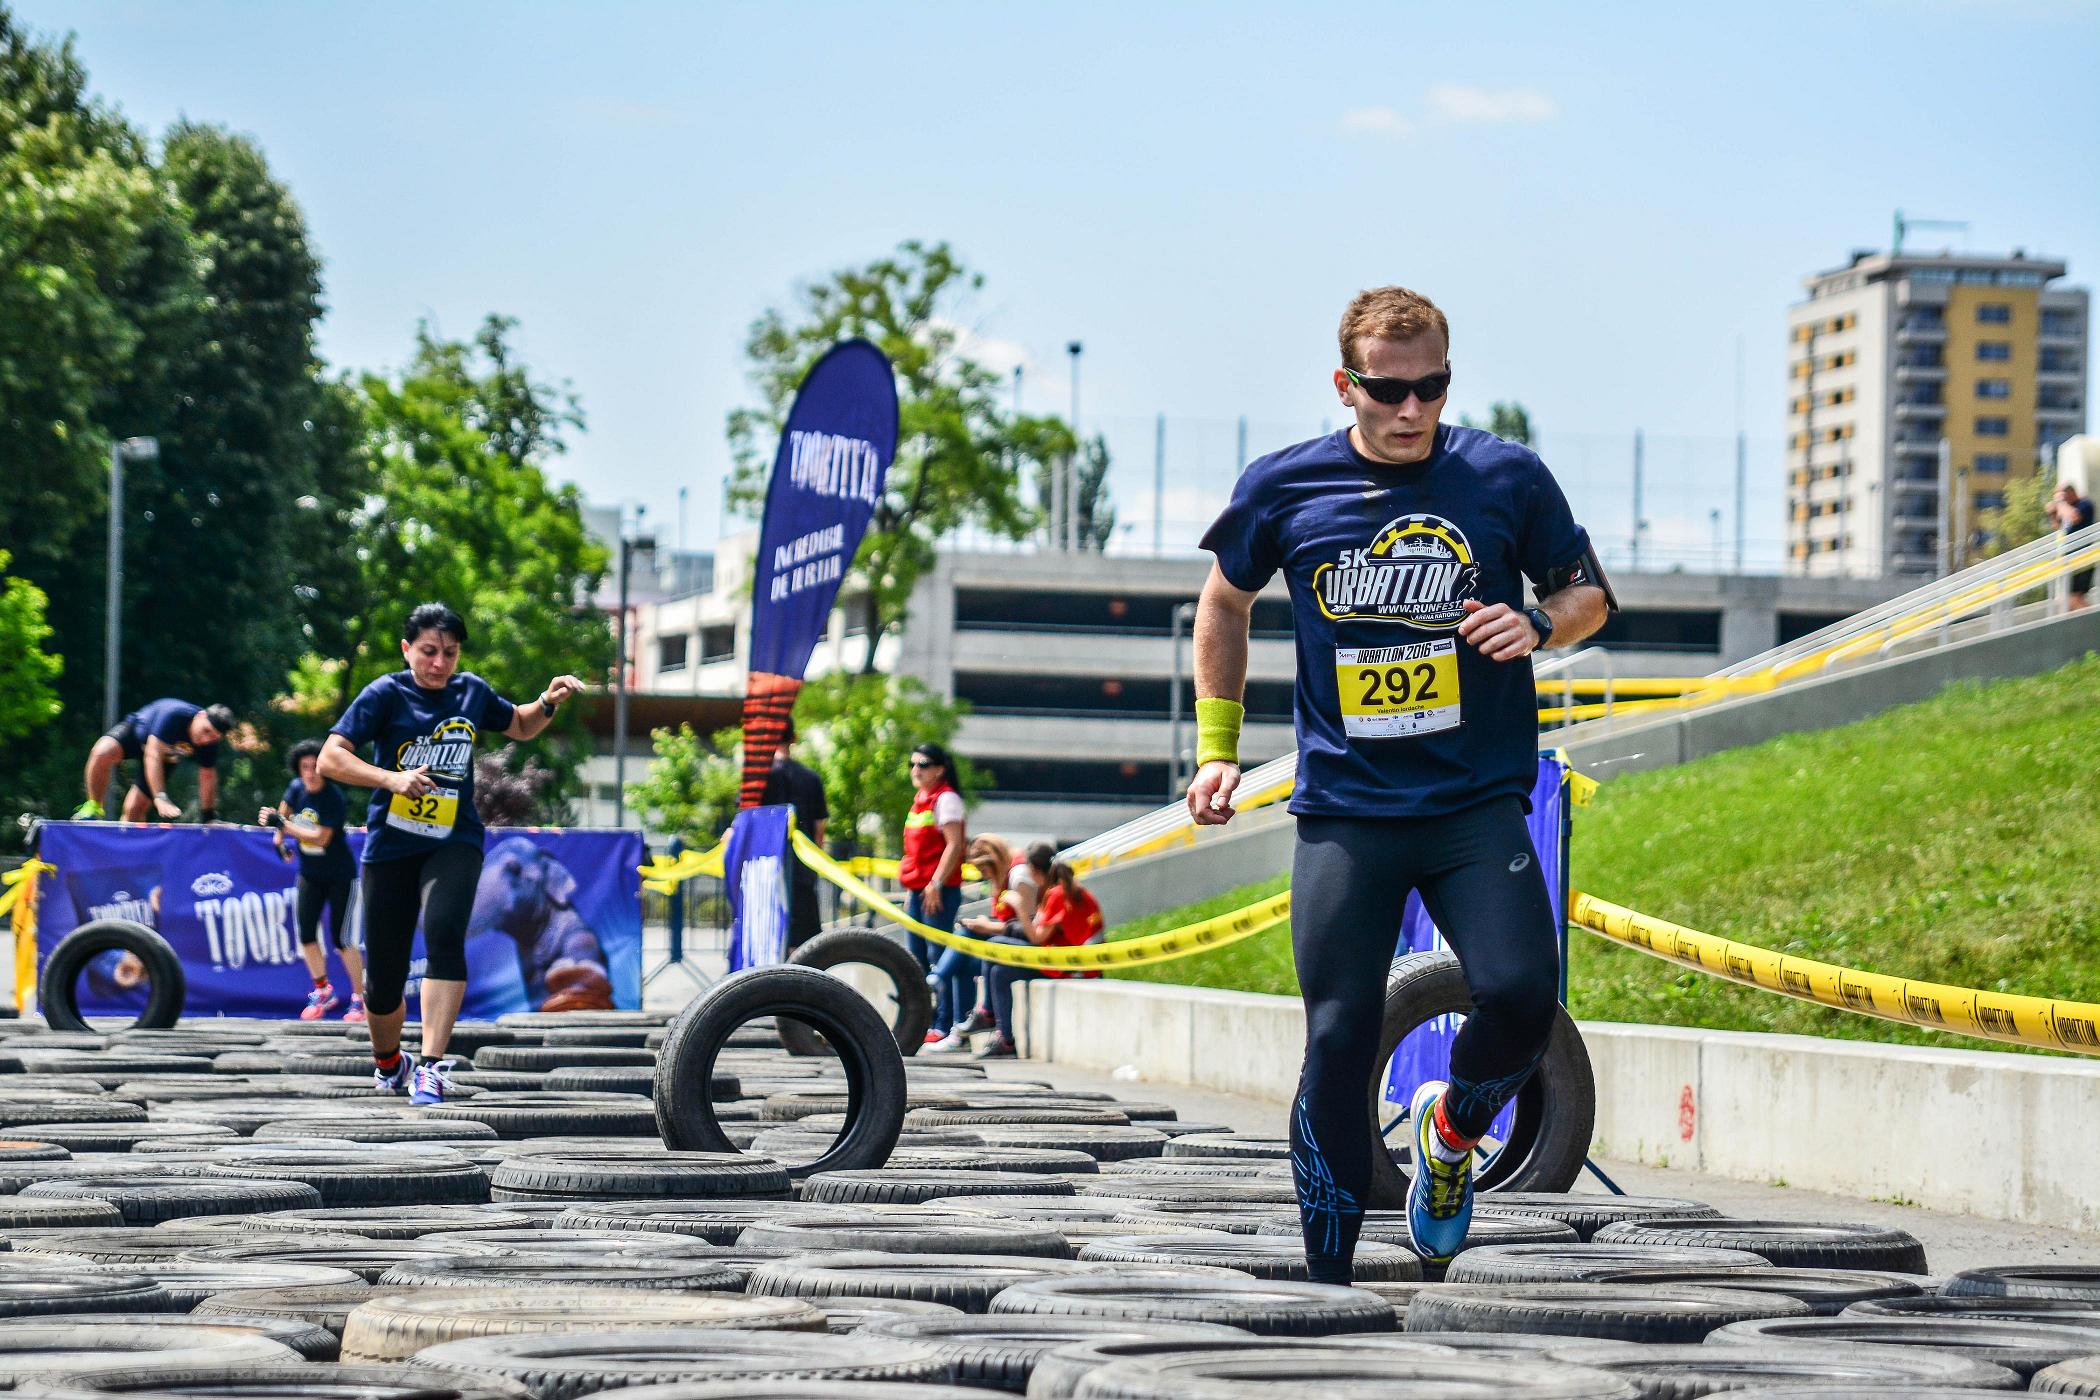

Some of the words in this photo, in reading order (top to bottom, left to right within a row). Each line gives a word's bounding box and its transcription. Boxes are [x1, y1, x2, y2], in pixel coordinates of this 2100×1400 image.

[1338, 548, 1370, 569] 5K
[1326, 563, 1461, 605] URBATLON
[1331, 604, 1351, 613] 2016
[1378, 600, 1463, 613] WWW.RUNFEST.
[1357, 646, 1406, 664] URBATLON
[1405, 643, 1432, 661] 2016
[1359, 663, 1439, 706] 292
[415, 735, 432, 746] 5K
[408, 797, 439, 820] 32
